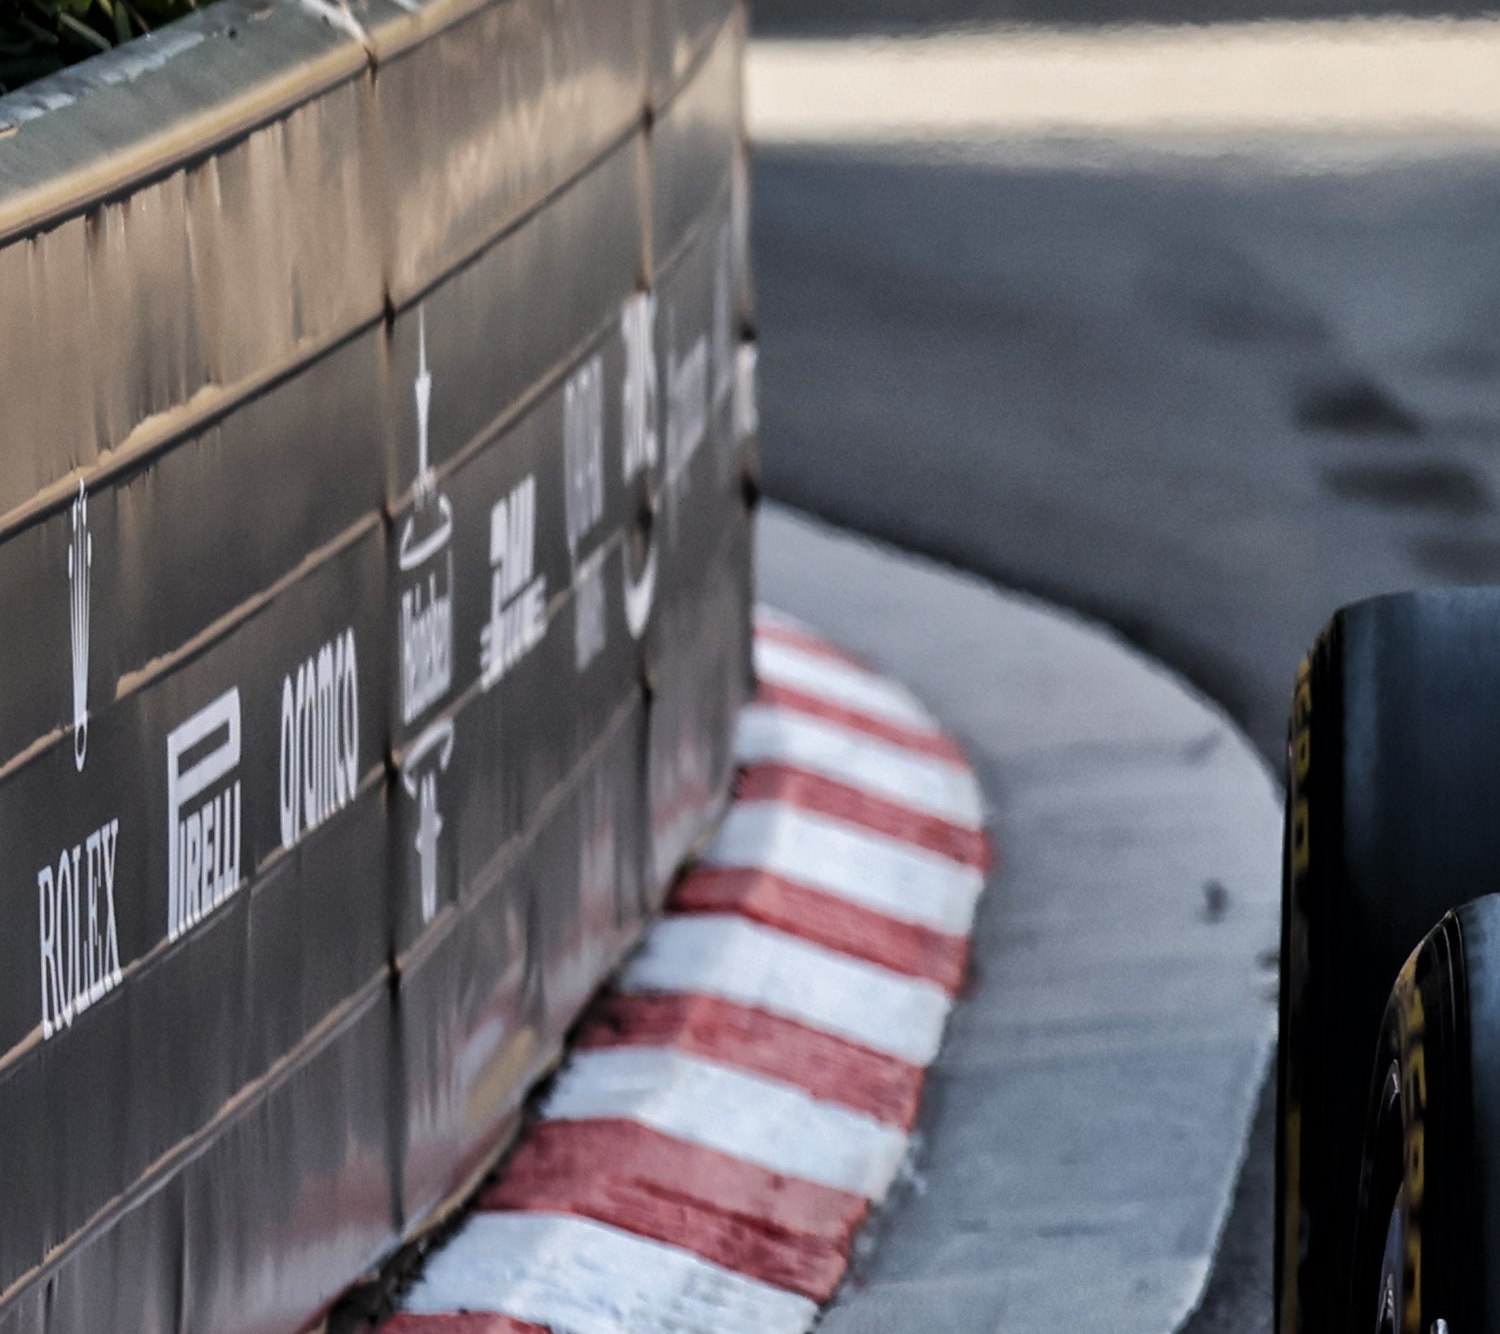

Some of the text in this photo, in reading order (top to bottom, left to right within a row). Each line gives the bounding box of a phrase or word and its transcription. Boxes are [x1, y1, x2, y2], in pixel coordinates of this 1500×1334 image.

[167, 685, 241, 943] PIRELLI
[280, 626, 359, 850] aramco
[37, 818, 124, 1041] ROLEX
